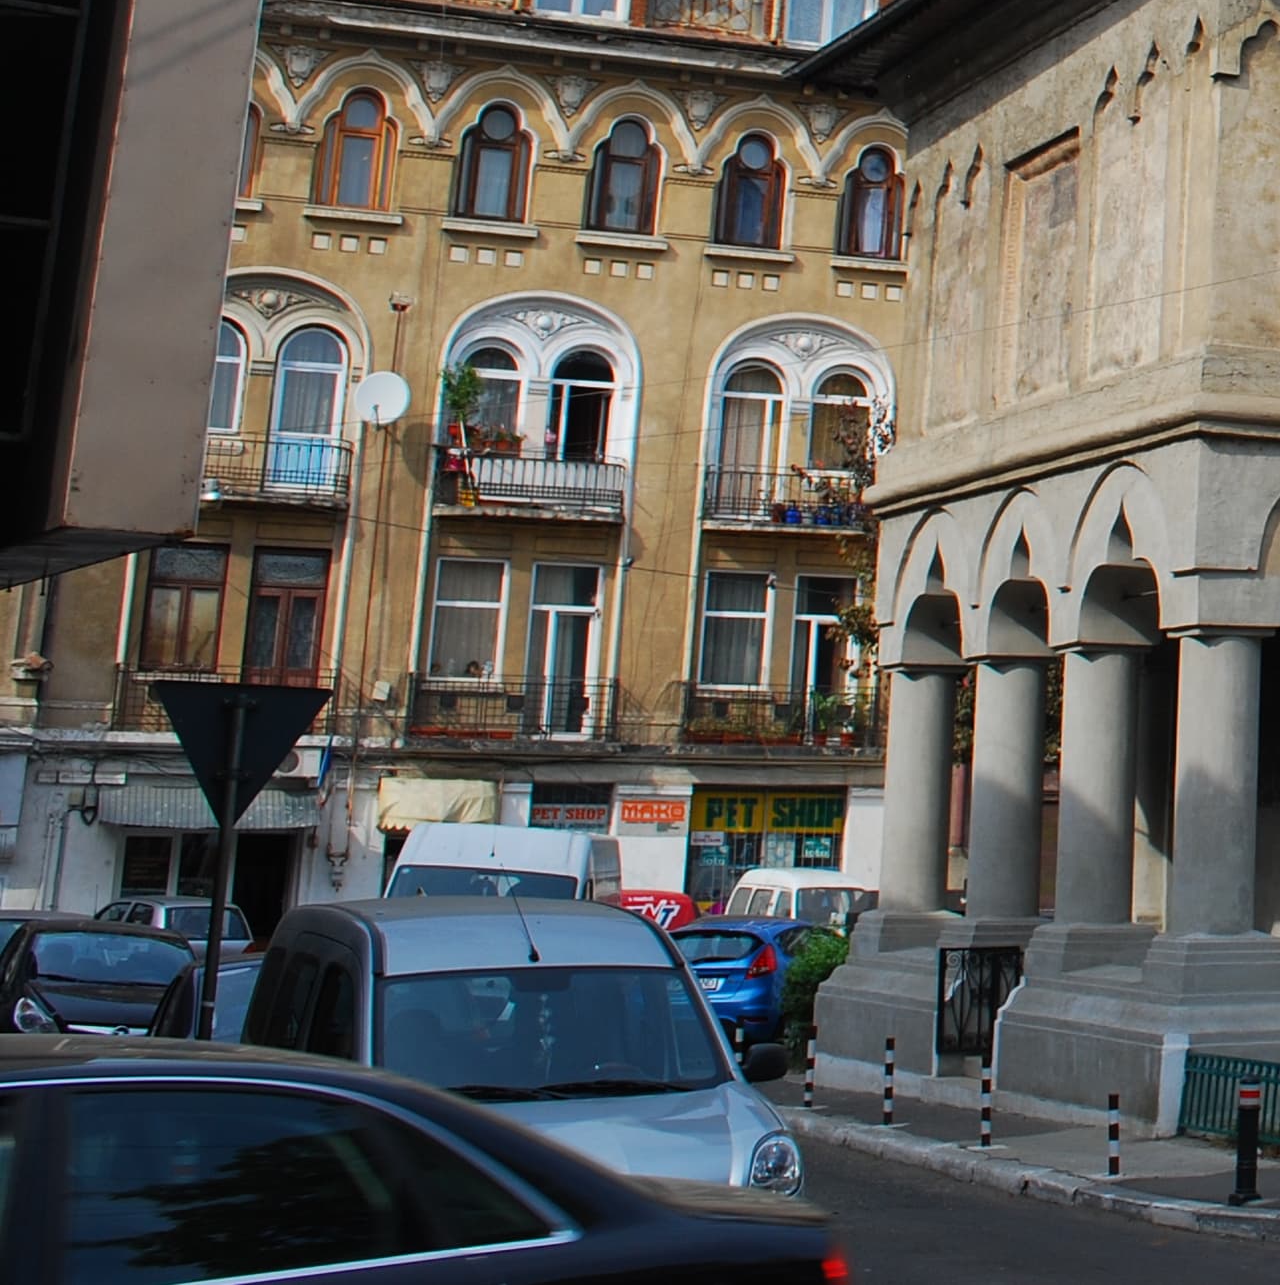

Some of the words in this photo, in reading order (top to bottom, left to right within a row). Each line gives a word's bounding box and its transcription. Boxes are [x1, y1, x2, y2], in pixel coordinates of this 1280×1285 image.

[532, 807, 561, 820] PET
[565, 807, 606, 820] SHOP
[623, 802, 685, 820] MAKO
[706, 797, 758, 828] PET
[772, 797, 844, 828] SHOP
